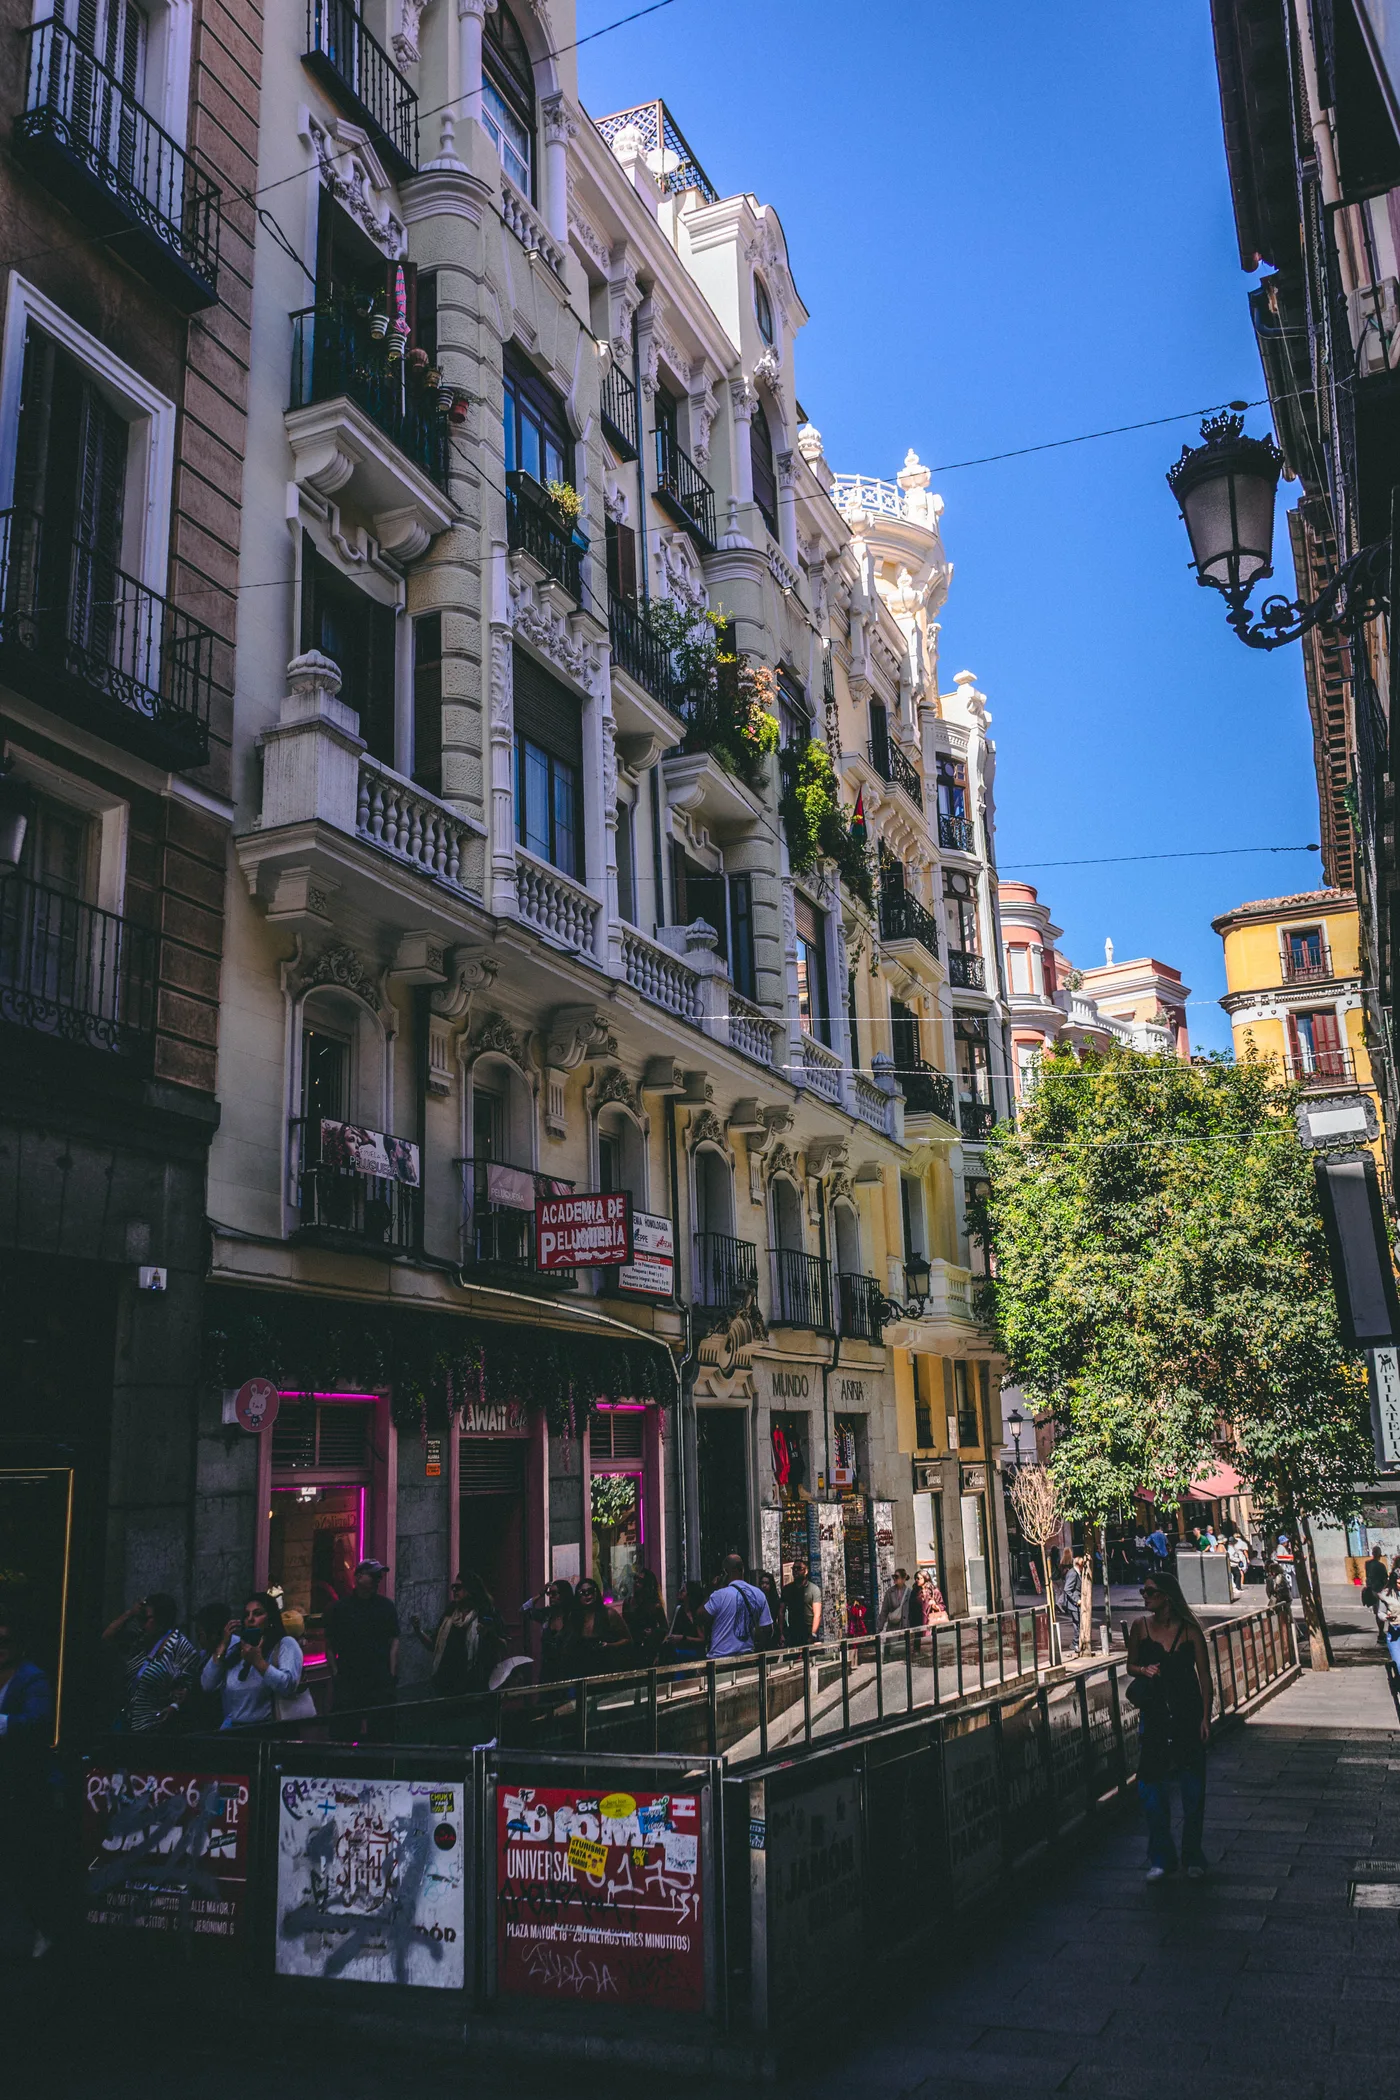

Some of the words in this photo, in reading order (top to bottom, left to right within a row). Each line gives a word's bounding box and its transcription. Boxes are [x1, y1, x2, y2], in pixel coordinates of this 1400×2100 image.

[541, 1200, 604, 1225] ACADEMIA
[607, 1197, 624, 1219] DE
[772, 1372, 809, 1398] MUNDO
[1383, 1374, 1400, 1460] FILATELIA
[225, 1799, 239, 1823] EL
[506, 1848, 578, 1883] UNIVERSAL
[507, 1922, 529, 1939] PLAZA
[530, 1924, 558, 1942] MAYOR,
[588, 1930, 620, 1947] METROS
[645, 1932, 691, 1953] MINUTITOS)
